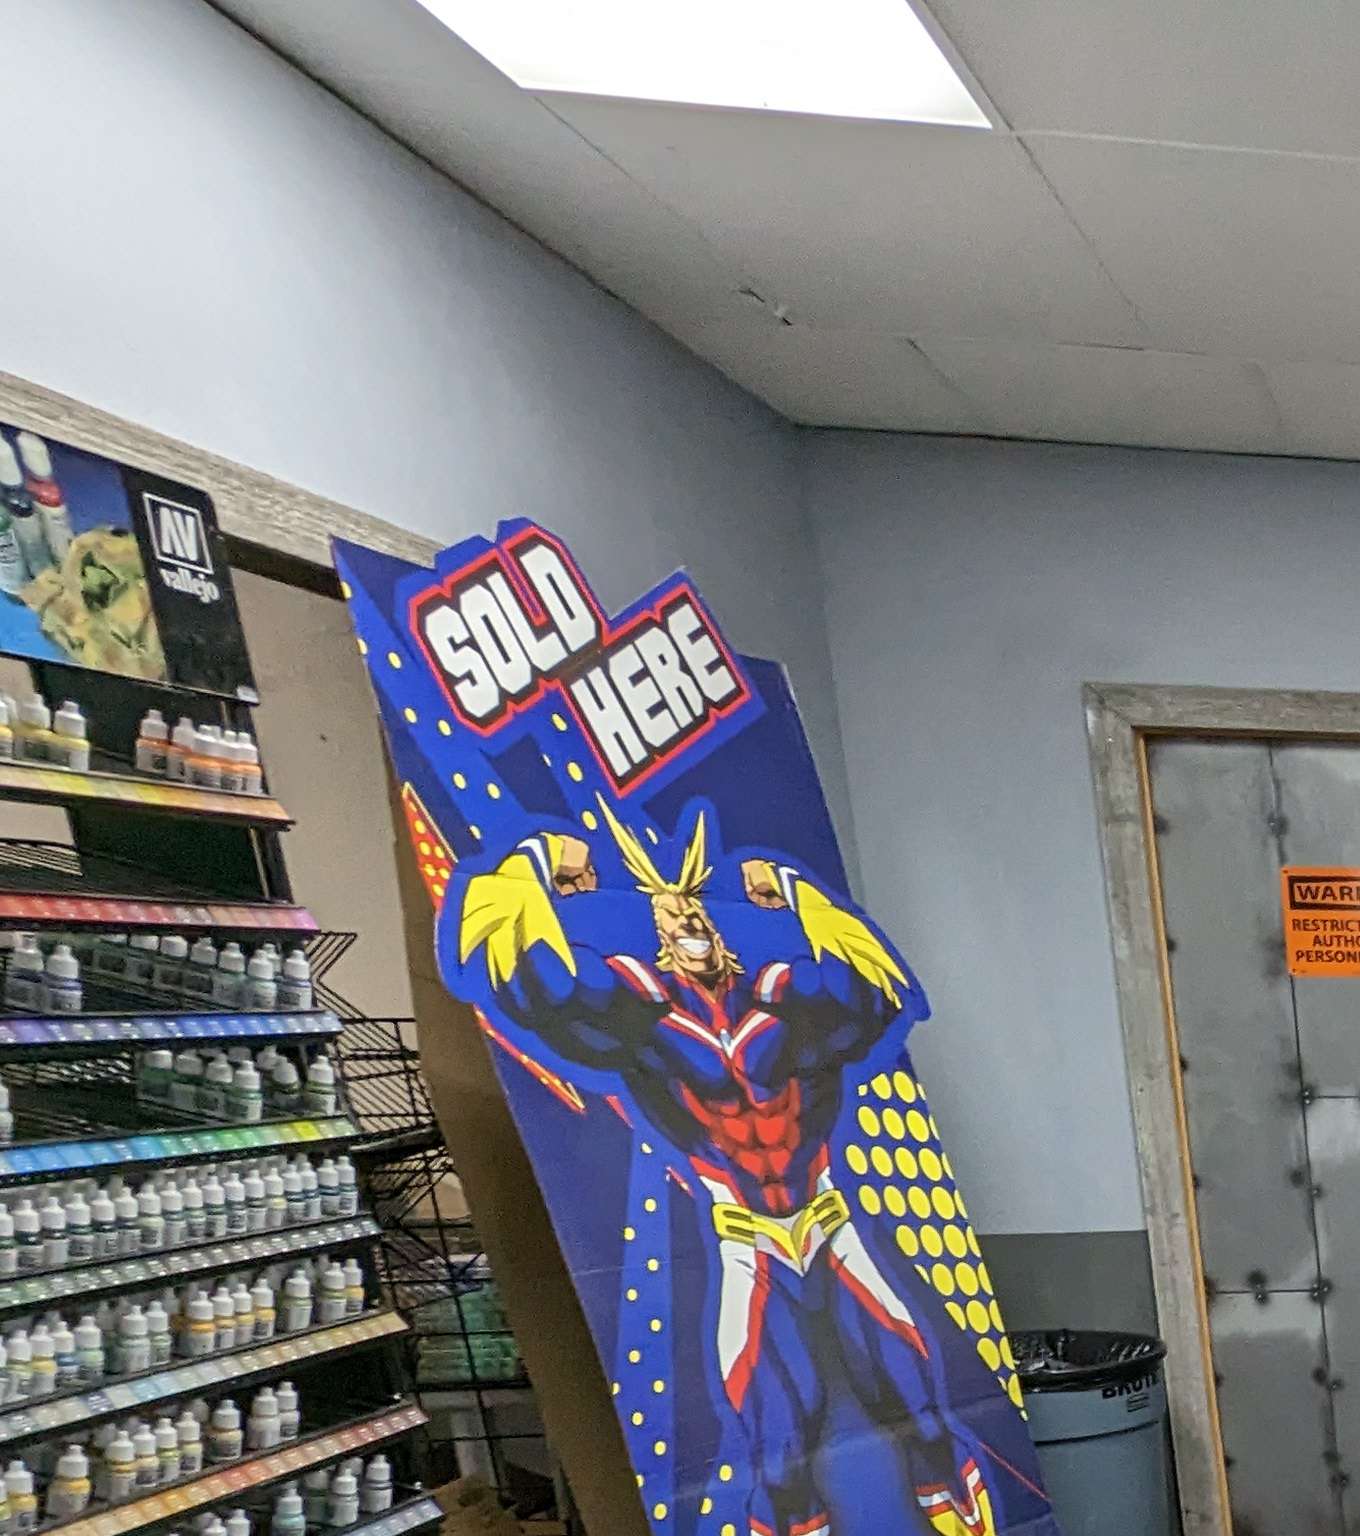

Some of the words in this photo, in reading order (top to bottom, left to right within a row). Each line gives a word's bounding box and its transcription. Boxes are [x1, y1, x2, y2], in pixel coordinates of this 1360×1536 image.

[160, 566, 221, 604] vallejo
[425, 543, 597, 718] SOLD
[570, 602, 737, 778] HERE
